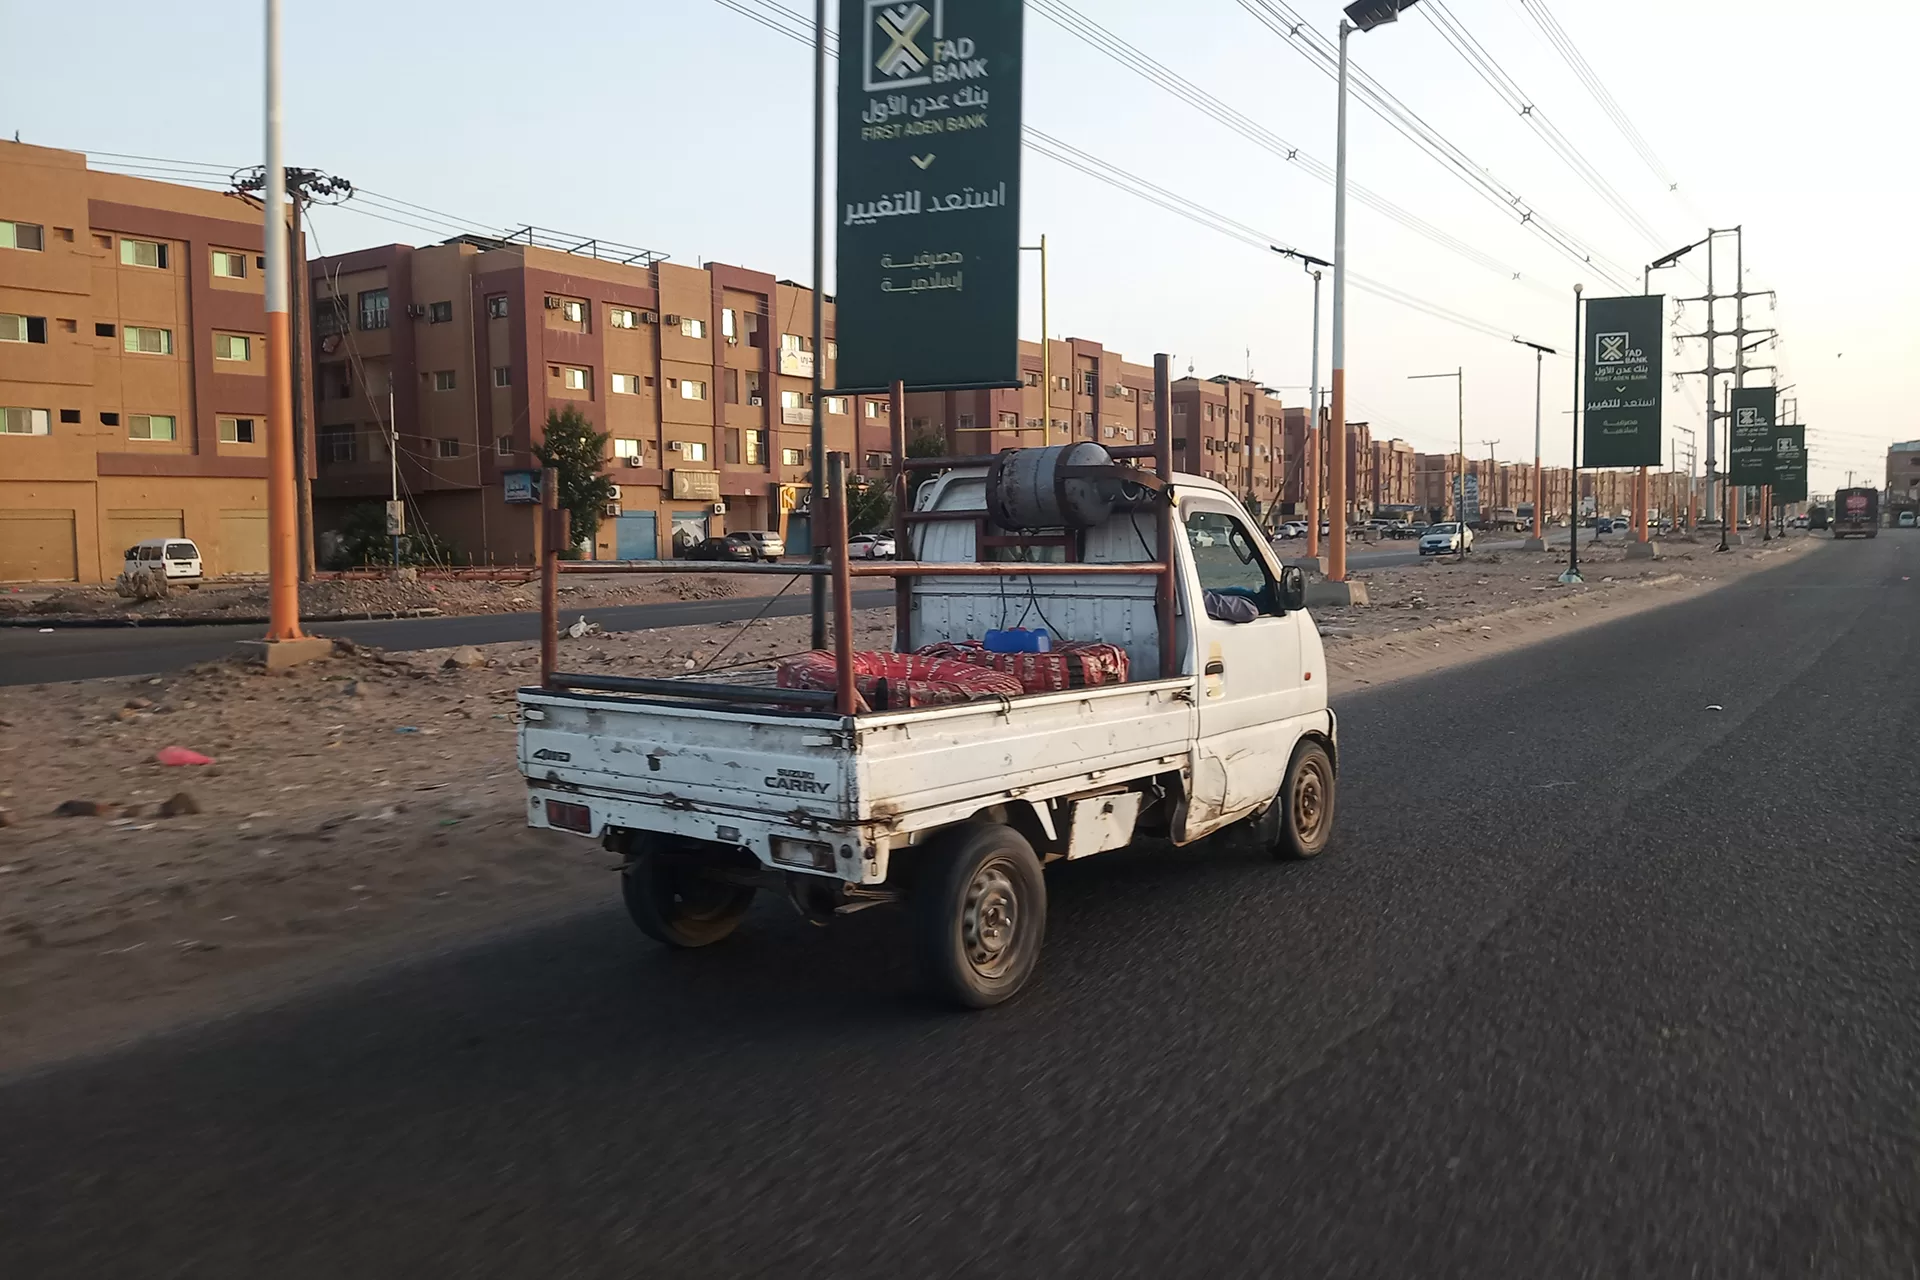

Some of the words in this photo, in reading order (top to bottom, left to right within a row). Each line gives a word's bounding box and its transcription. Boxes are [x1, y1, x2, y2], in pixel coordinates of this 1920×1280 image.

[933, 37, 976, 63] FAD
[933, 58, 989, 83] BANK
[910, 95, 950, 118] عدن
[953, 85, 989, 109] بنك
[861, 124, 902, 141] FIRST
[903, 119, 944, 136] ADEN
[946, 113, 988, 131] BANK
[844, 190, 921, 226] للتغيير
[926, 181, 1006, 213] استعد
[1625, 356, 1648, 364] BANK
[1623, 397, 1656, 408] استعد
[764, 776, 831, 794] CARRY
[777, 768, 815, 780] SUZUKI
